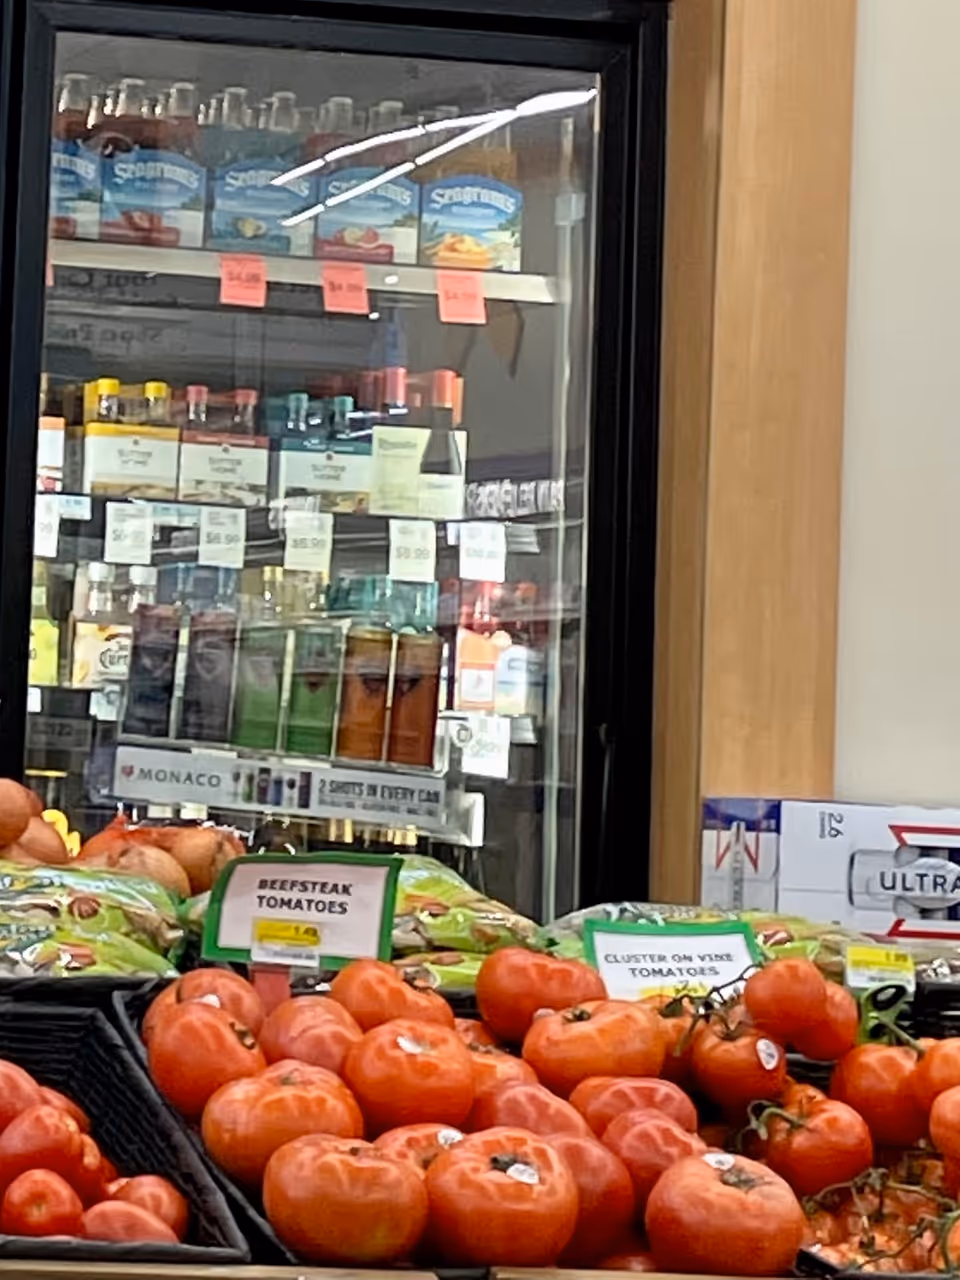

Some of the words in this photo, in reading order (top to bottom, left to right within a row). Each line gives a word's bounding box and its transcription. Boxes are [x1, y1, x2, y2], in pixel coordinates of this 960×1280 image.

[138, 767, 221, 788] MONACO
[318, 778, 326, 793] 2
[328, 779, 364, 796] SHOTS
[366, 781, 378, 797] IN
[380, 782, 415, 802] EVERY
[418, 785, 441, 804] CAN
[258, 878, 353, 898] BEEFSTEAK
[879, 870, 960, 893] ULTRA
[256, 894, 349, 915] TOMATOES
[604, 952, 668, 964] CLUSTER
[671, 952, 694, 964] ON
[697, 952, 735, 964] VINE
[628, 964, 721, 978] TOMATOES
